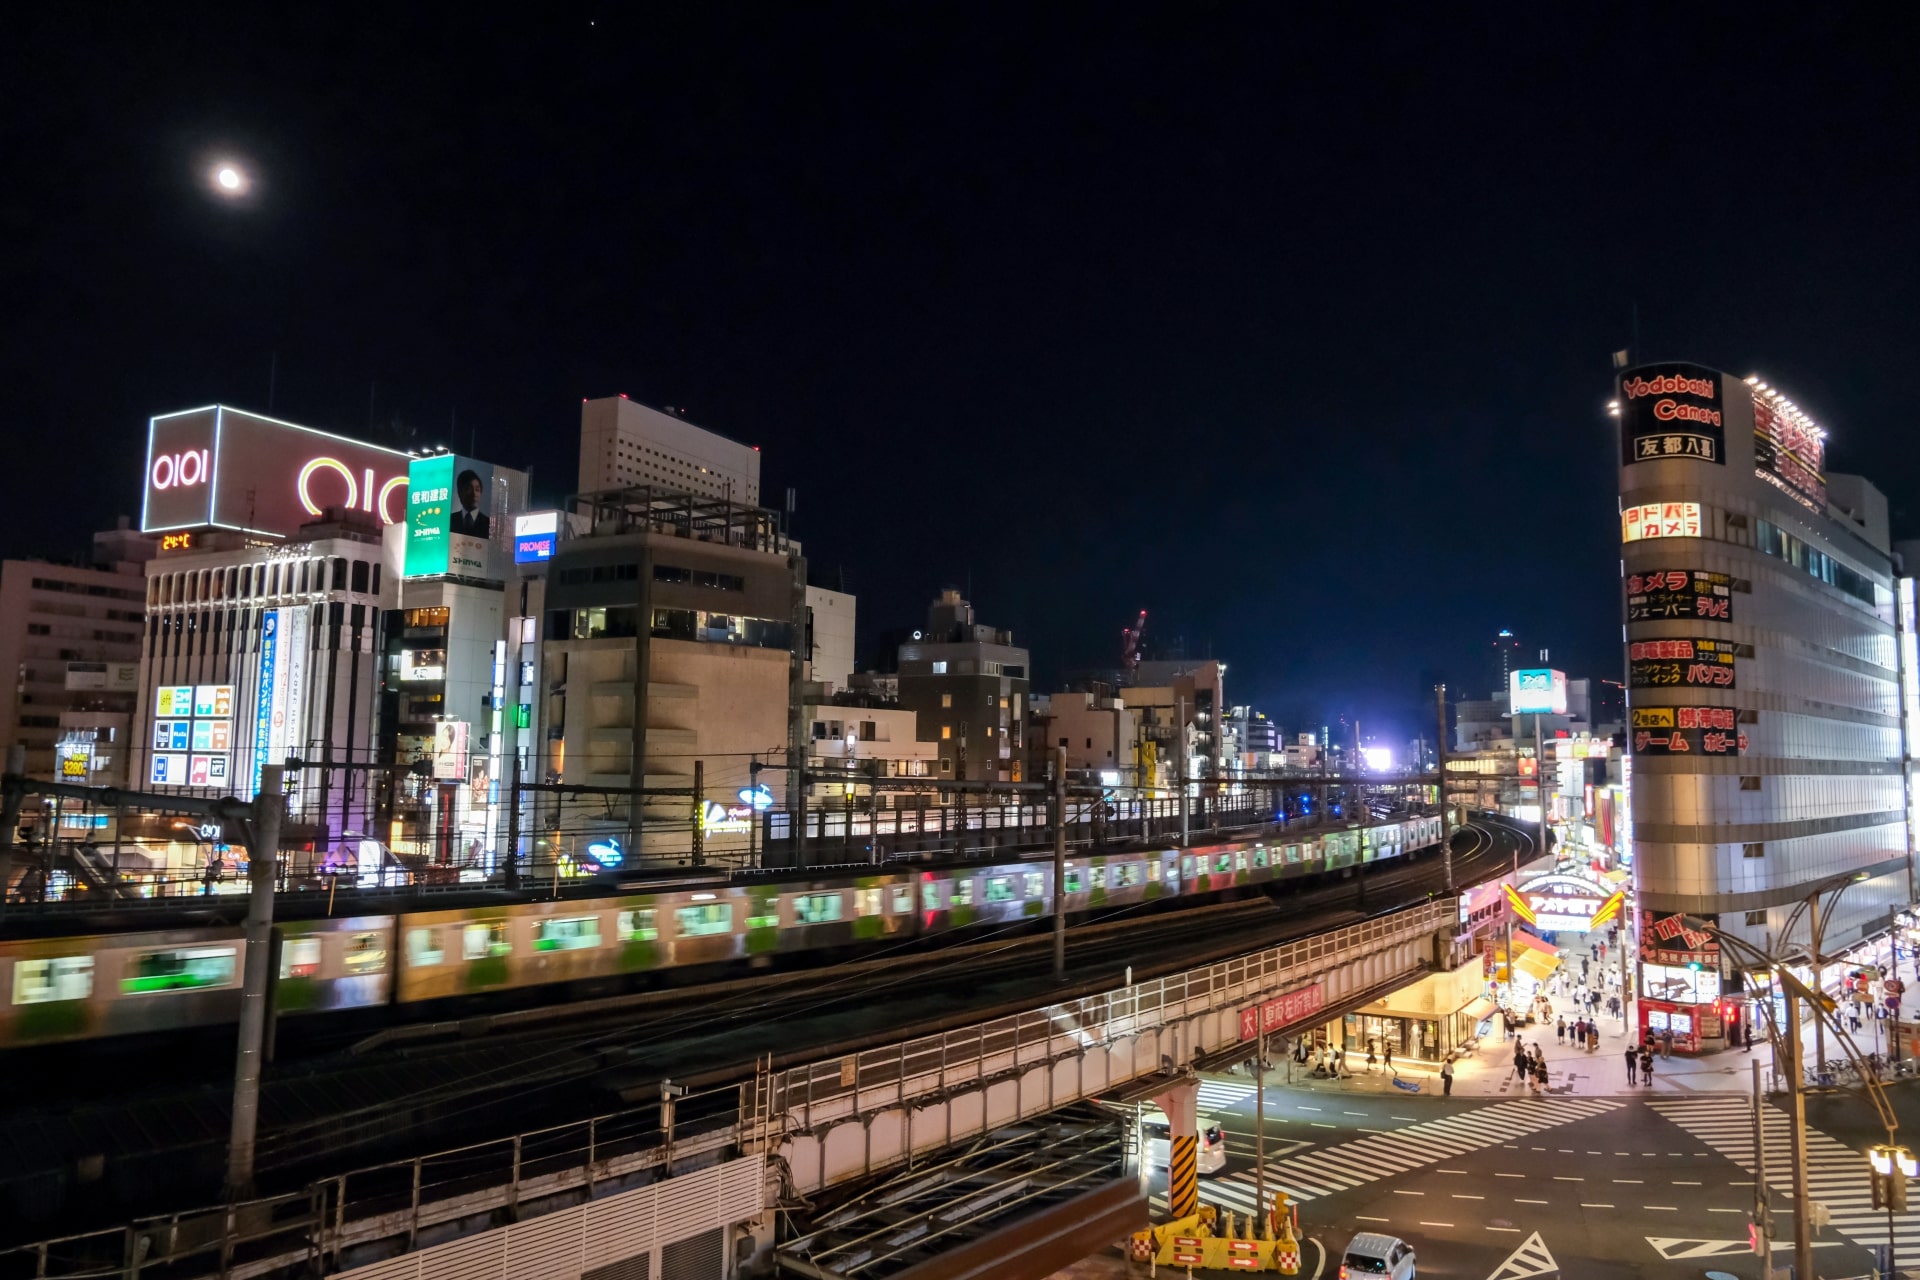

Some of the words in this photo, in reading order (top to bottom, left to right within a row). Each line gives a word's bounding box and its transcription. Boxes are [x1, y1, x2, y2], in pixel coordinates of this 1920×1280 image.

[1623, 374, 1714, 400] Yodobashi
[1653, 399, 1721, 427] Camera
[1641, 436, 1711, 457] 友都八喜
[411, 487, 448, 505] 信和建設
[1628, 504, 1698, 524] ヨドバシ
[1645, 522, 1698, 537] カメラ
[519, 540, 550, 553] PROMISE
[1628, 571, 1688, 595] カメラ
[1630, 603, 1691, 618] シェーバー
[1697, 596, 1729, 619] テレビ
[1632, 663, 1681, 674] スーツケース
[1652, 674, 1681, 684] インク
[1687, 663, 1734, 685] パソコン
[1633, 710, 1671, 726] 2号店へ
[1678, 707, 1734, 729] 携帯電話
[1635, 731, 1690, 752] ゲーム
[1703, 731, 1736, 753] ホビー
[1244, 989, 1320, 1035] 大車両左折禁止
